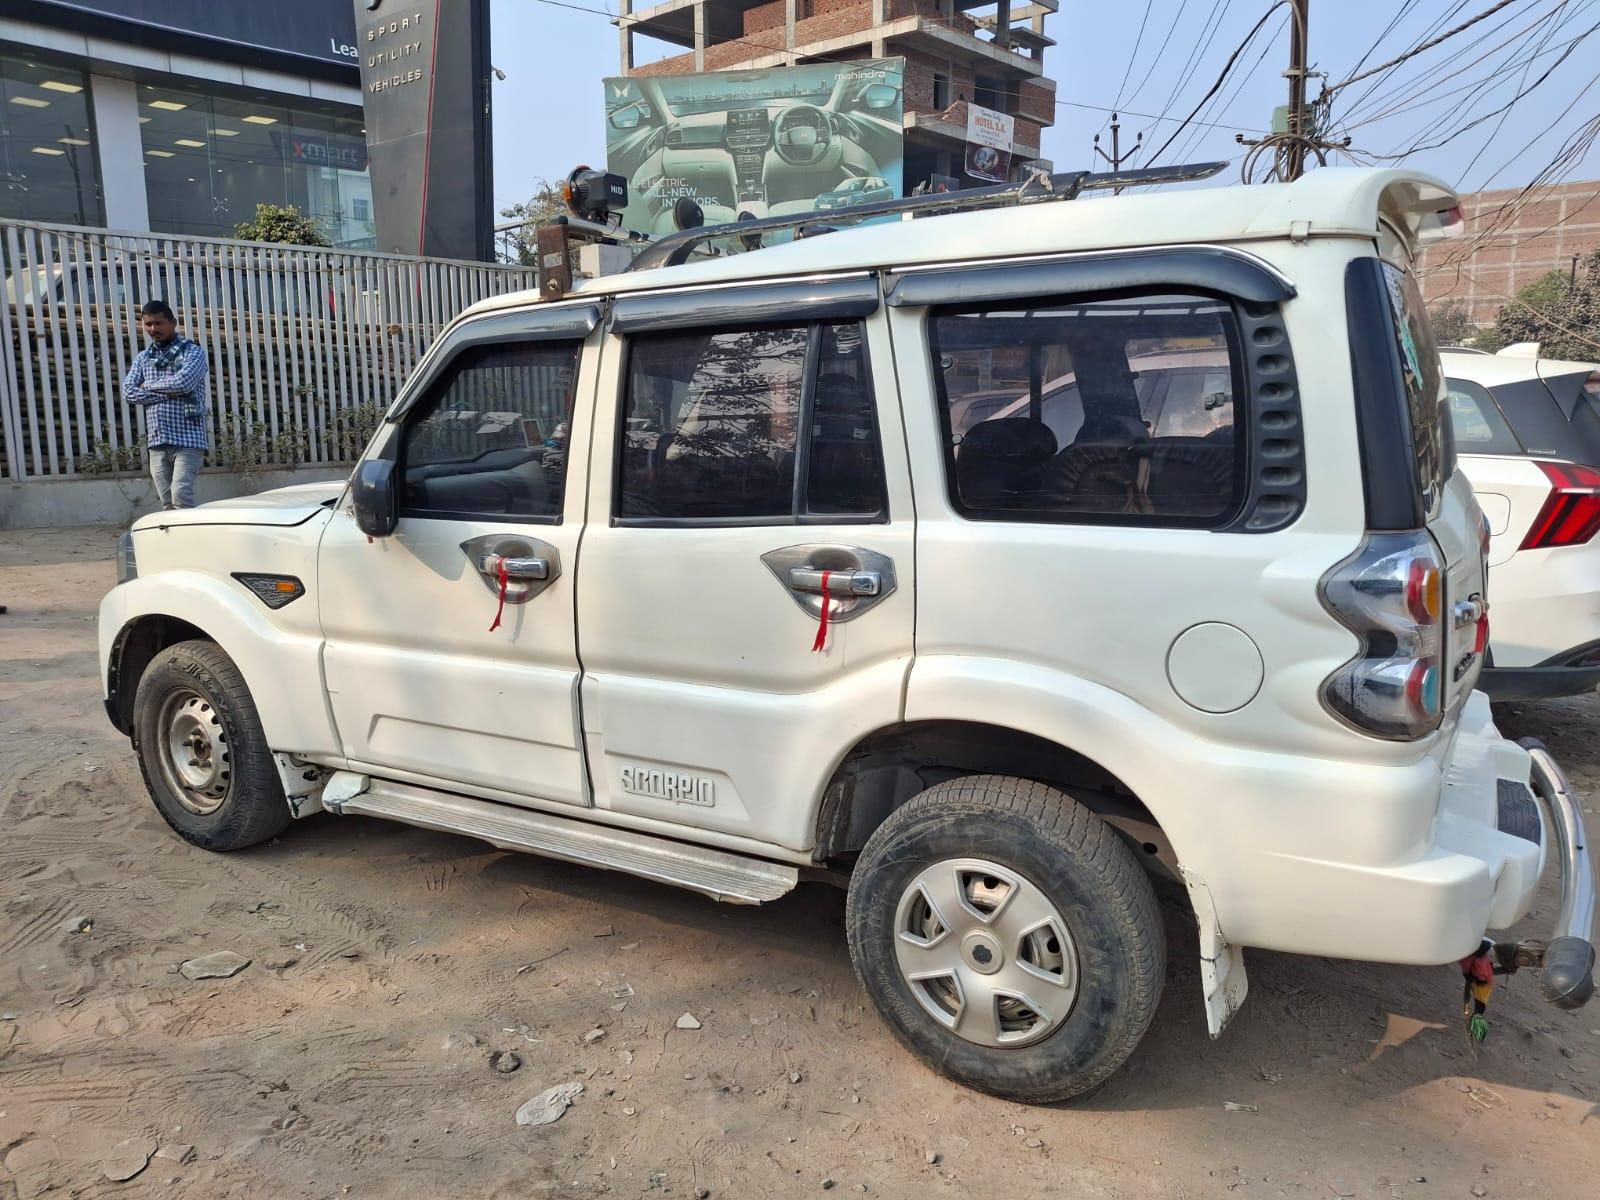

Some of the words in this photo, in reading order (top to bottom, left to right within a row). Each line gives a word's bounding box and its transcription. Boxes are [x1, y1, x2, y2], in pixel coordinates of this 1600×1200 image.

[368, 13, 422, 41] SPORT
[368, 42, 422, 67] UTILITY
[369, 69, 422, 94] VEHICLES
[834, 70, 886, 81] mahindra
[975, 115, 994, 131] HOTEL
[610, 184, 624, 195] HID
[621, 765, 716, 807] SCORPIO
